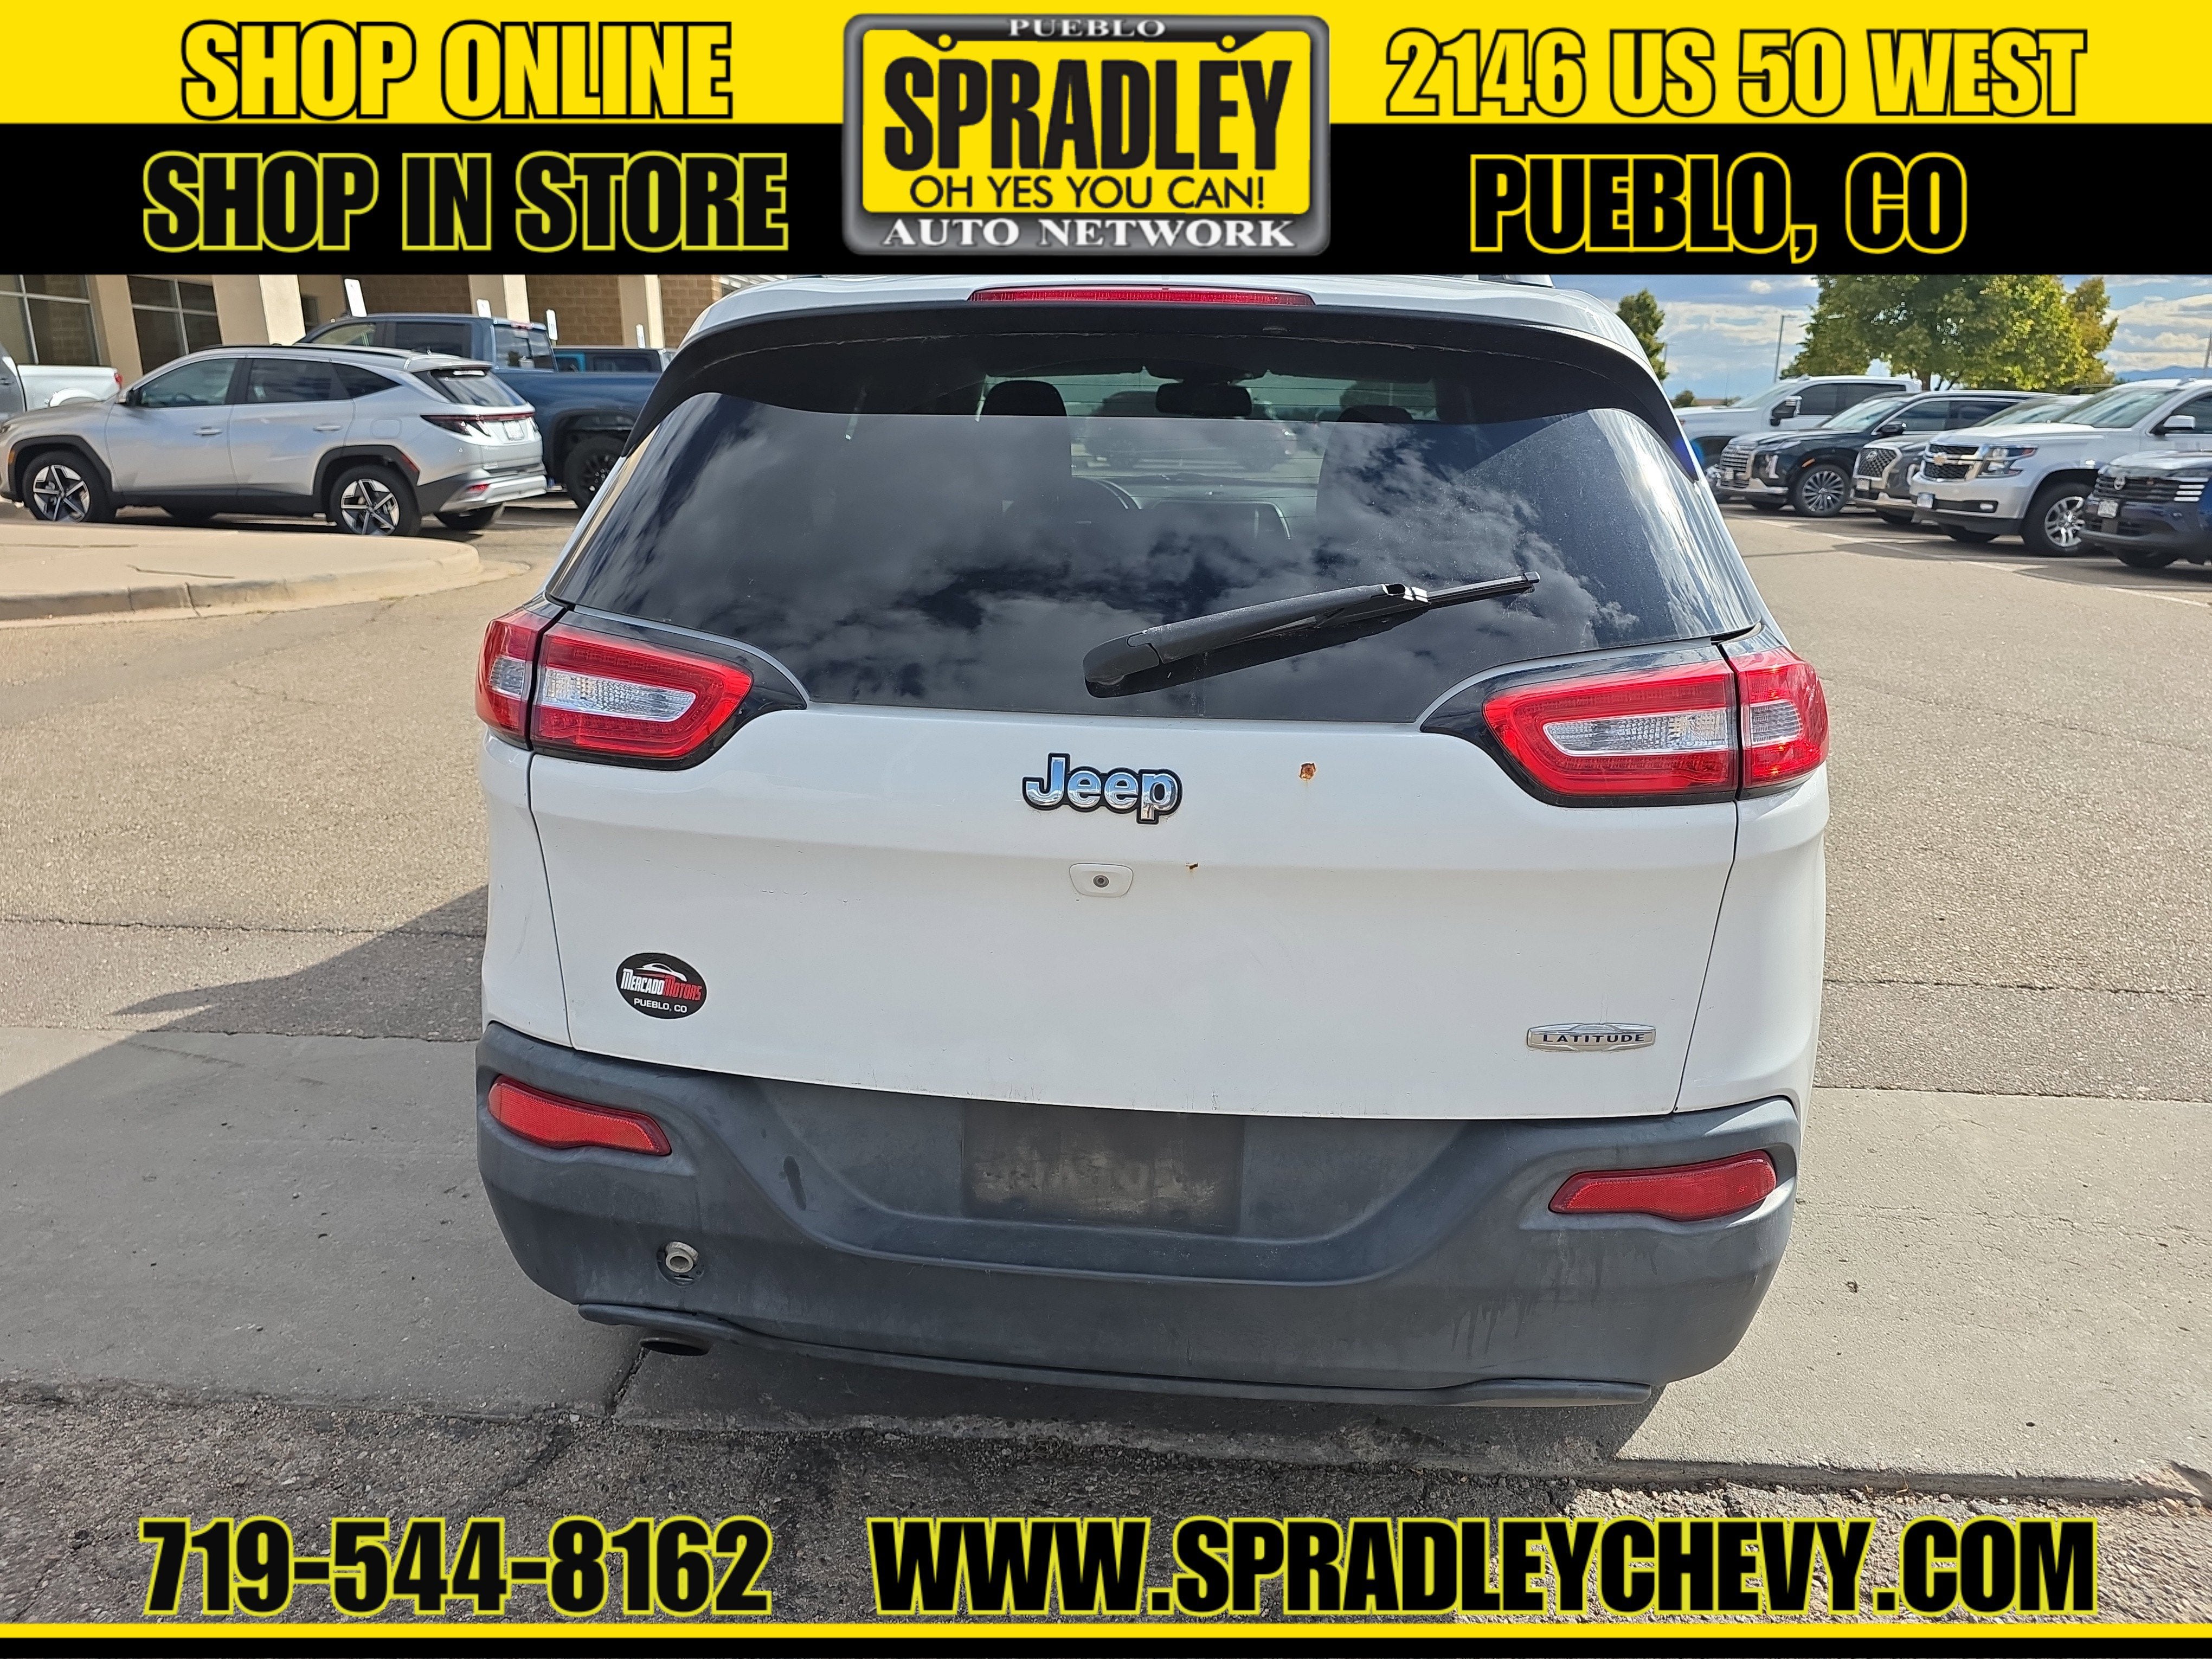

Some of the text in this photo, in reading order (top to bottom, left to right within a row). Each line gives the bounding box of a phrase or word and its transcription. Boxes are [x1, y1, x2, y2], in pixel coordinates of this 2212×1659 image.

[1023, 753, 1182, 824] Jeep
[634, 998, 687, 1013] PUEBLO, CO
[1543, 1034, 1645, 1043] LATITUDE
